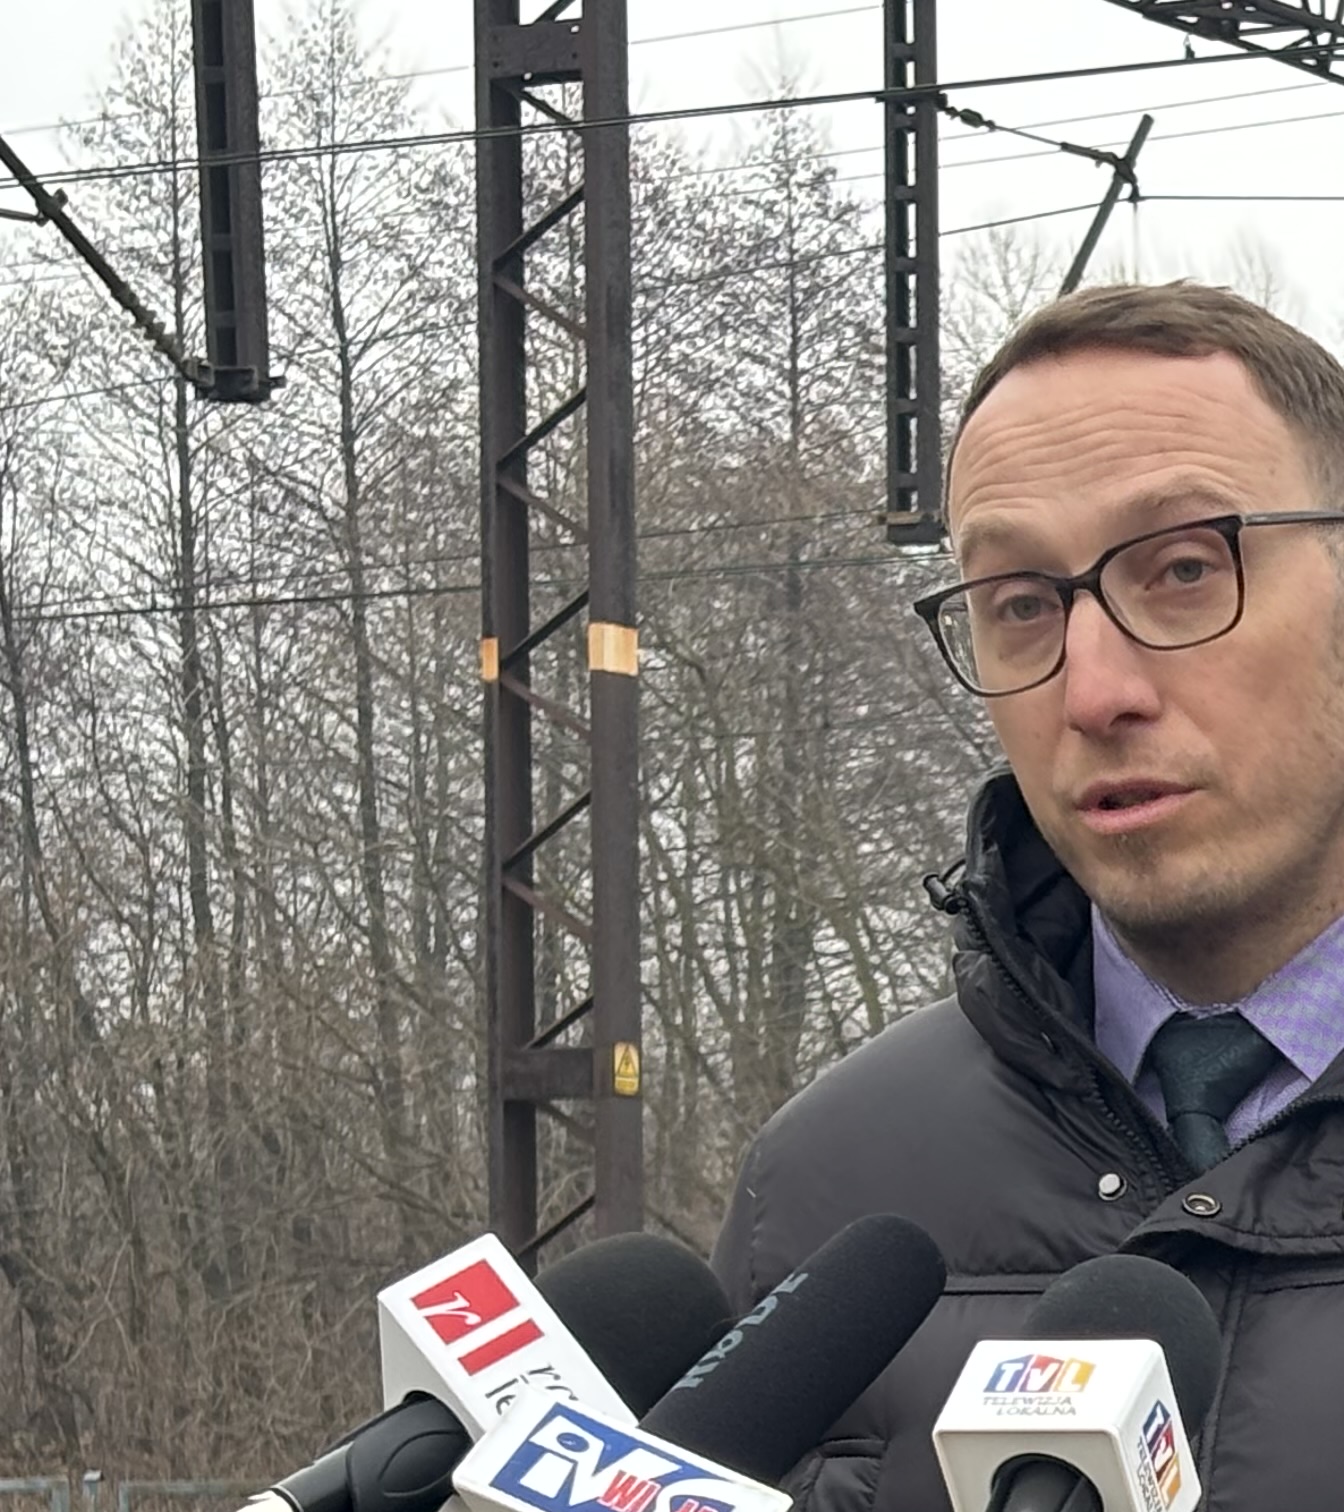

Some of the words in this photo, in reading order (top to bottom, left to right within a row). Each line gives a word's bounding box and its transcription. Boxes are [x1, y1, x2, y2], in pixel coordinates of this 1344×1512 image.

[985, 1355, 1095, 1393] TVL
[983, 1396, 1072, 1406] TELEWIZJA
[996, 1406, 1077, 1416] LOKALNA
[1142, 1399, 1182, 1512] TVL
